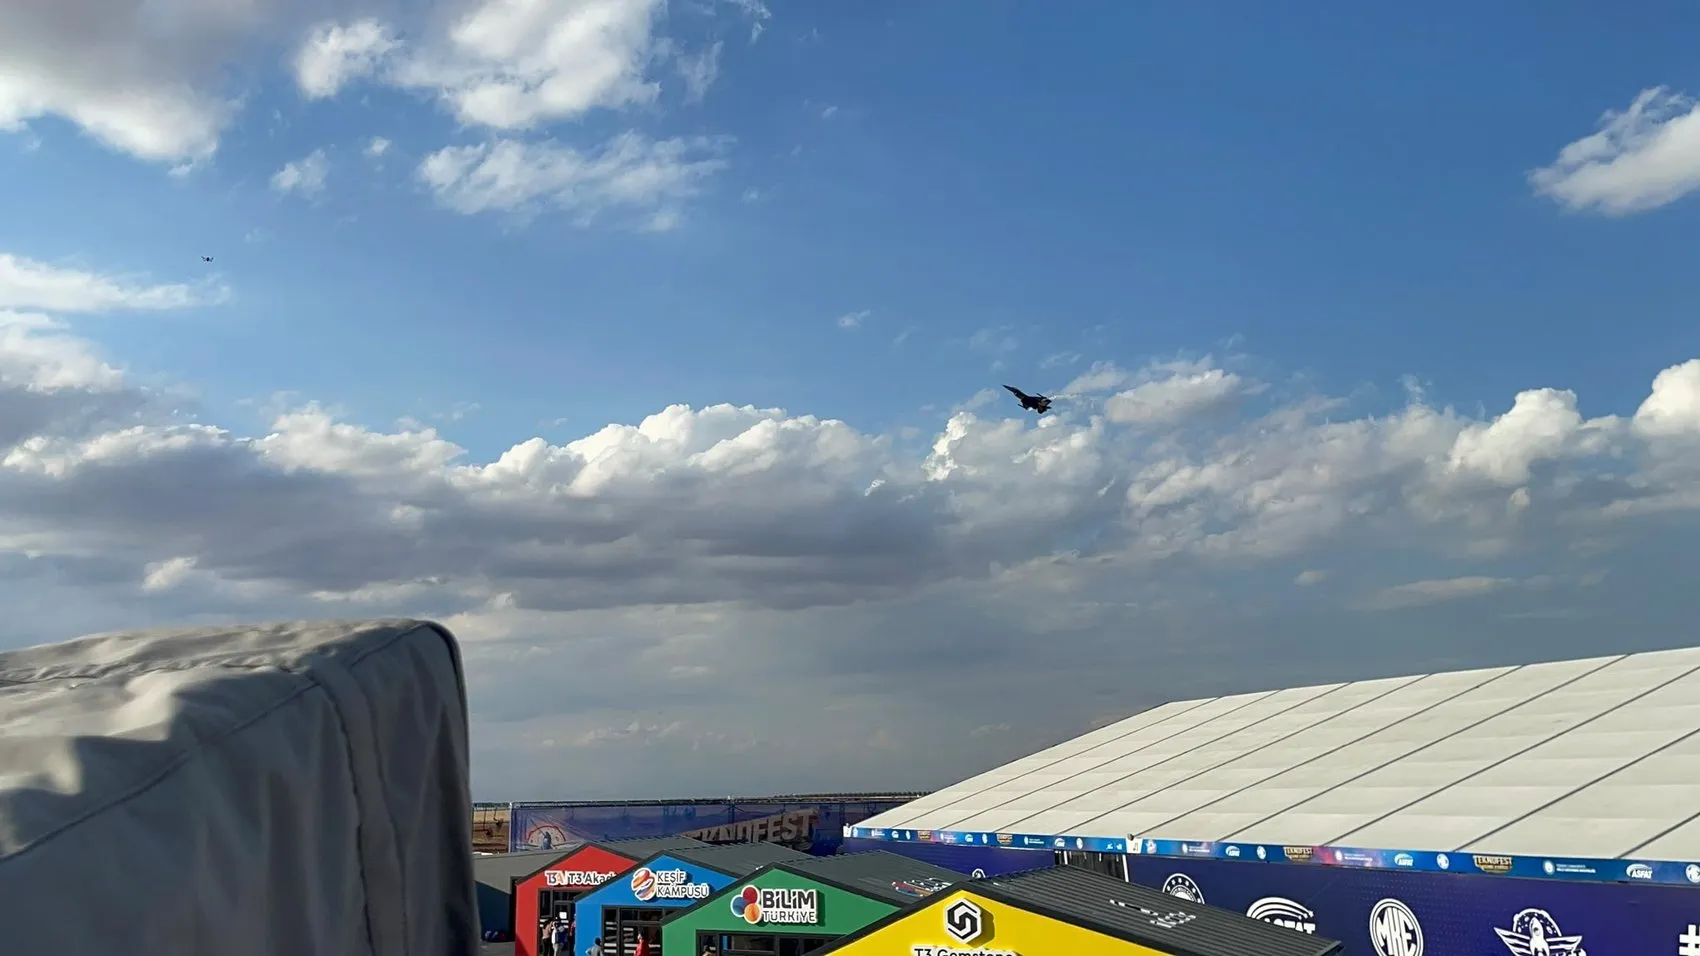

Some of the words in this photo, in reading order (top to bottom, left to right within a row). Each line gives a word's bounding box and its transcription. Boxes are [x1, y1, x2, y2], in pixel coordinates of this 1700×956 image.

[568, 873, 584, 884] T3
[657, 869, 685, 883] KEŞİF
[657, 884, 708, 897] KAMPÜSÜ
